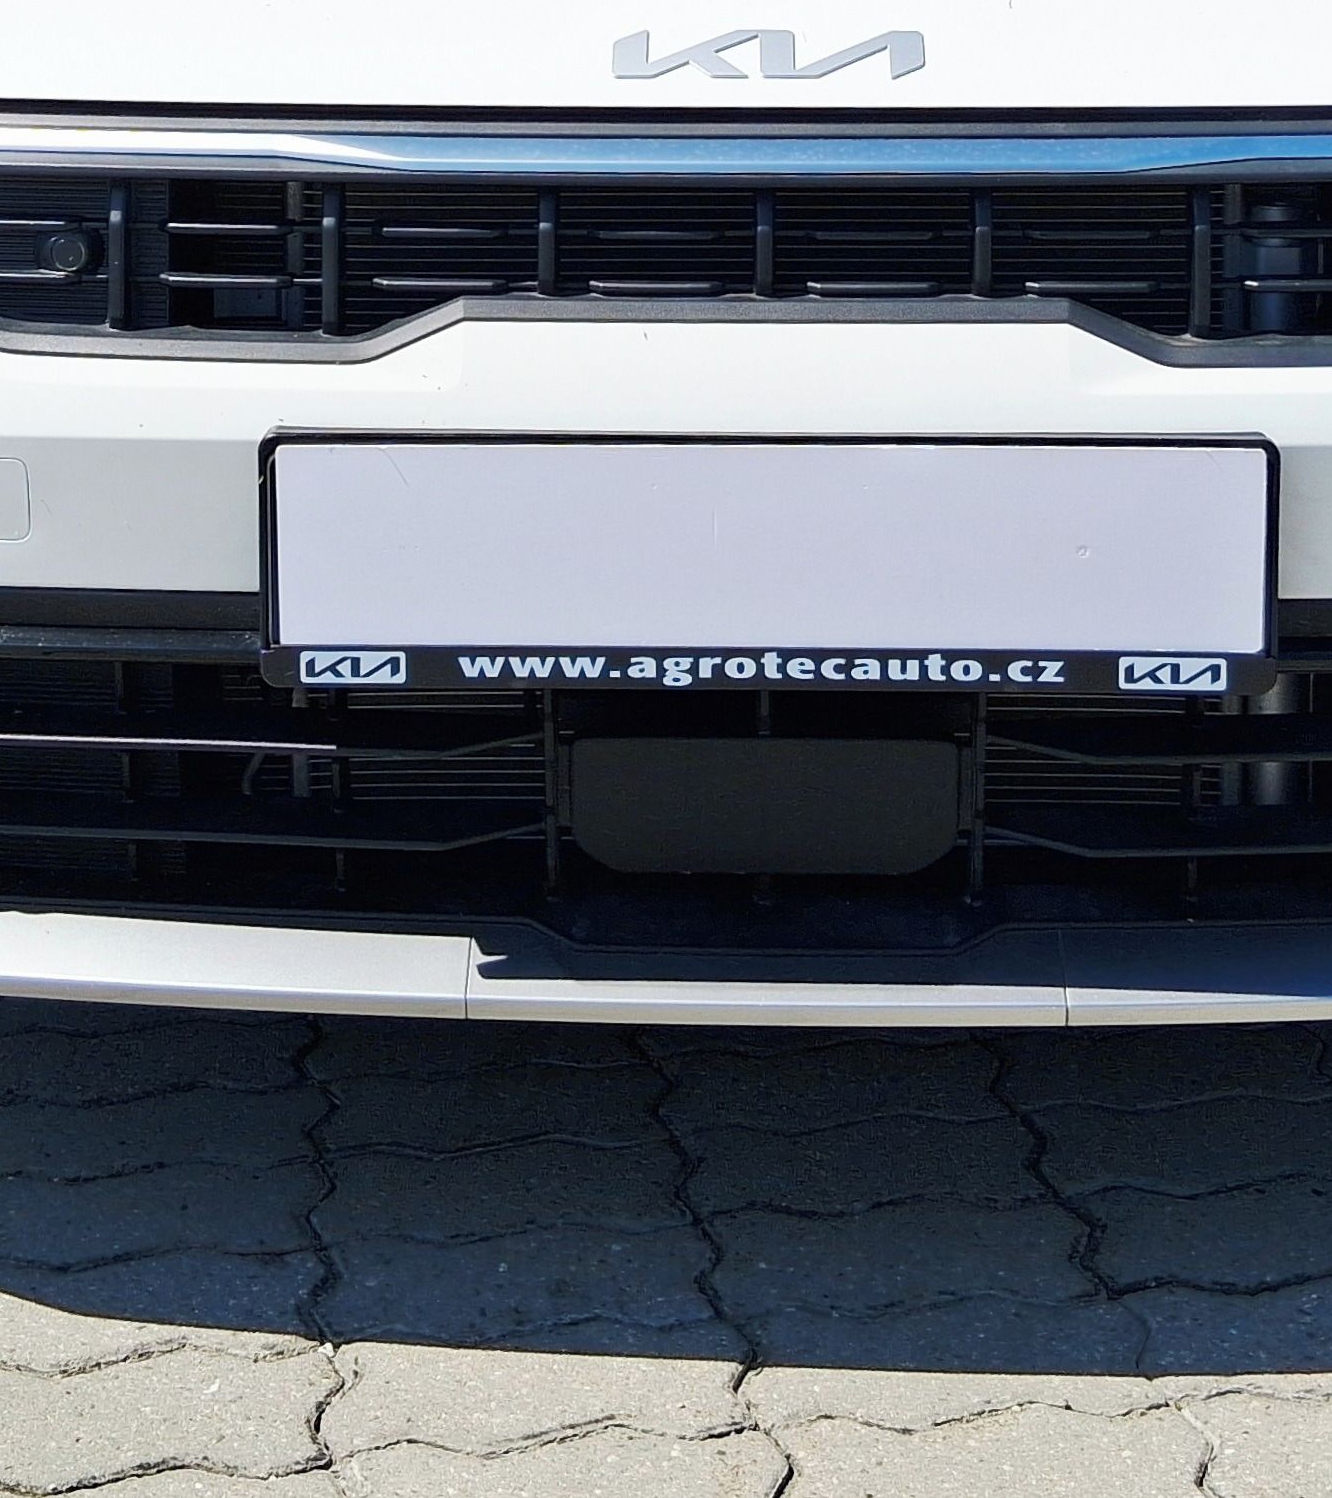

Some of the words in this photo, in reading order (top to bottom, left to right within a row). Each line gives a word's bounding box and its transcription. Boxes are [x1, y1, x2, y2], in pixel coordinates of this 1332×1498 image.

[612, 29, 926, 80] KIA
[304, 655, 401, 679] KIA
[457, 651, 1066, 687] www.agrotecauto.cz
[1123, 661, 1222, 685] KIA
